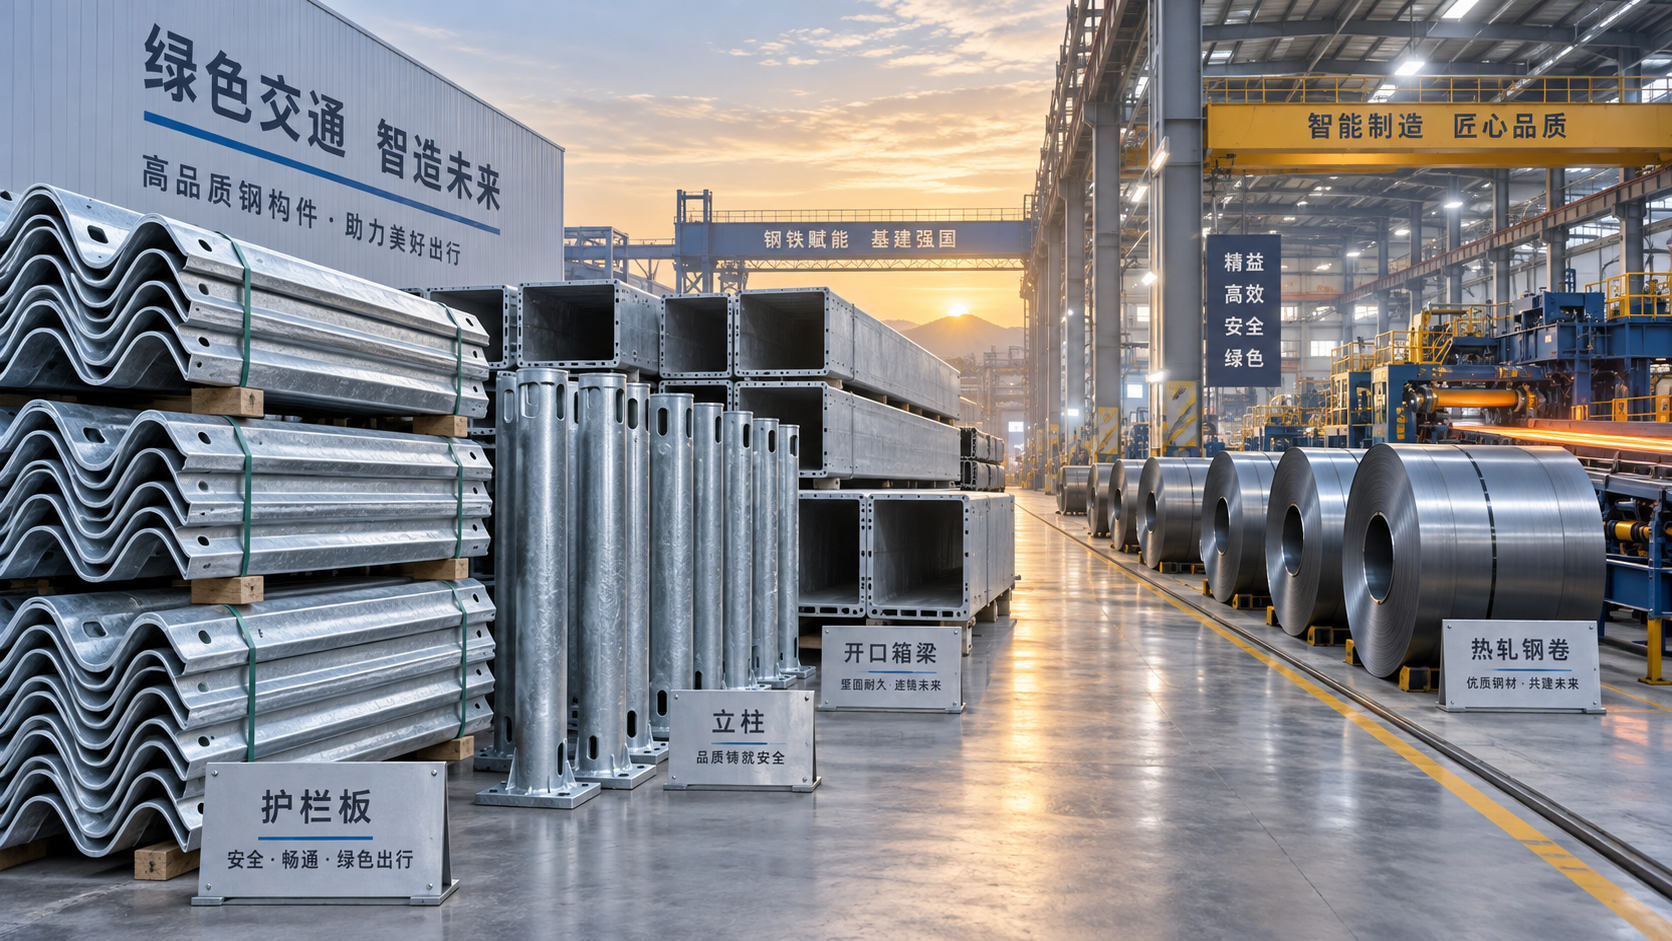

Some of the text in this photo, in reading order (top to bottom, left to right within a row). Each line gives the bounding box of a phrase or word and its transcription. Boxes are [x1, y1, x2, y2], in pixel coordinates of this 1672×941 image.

[143, 23, 501, 212] 绿色交通 智造未来
[1307, 112, 1568, 140] 智能制造 匠心品质
[763, 229, 957, 249] 钢铁赋能 基建强国
[1223, 251, 1265, 273] 精益
[1223, 283, 1265, 305] 高效
[1223, 315, 1265, 337] 安全
[1223, 347, 1265, 369] 绿色
[844, 641, 937, 664] 开口箱梁
[1471, 637, 1570, 661] 热轧钢卷
[711, 708, 765, 734] 立柱
[261, 788, 372, 825] 护栏板
